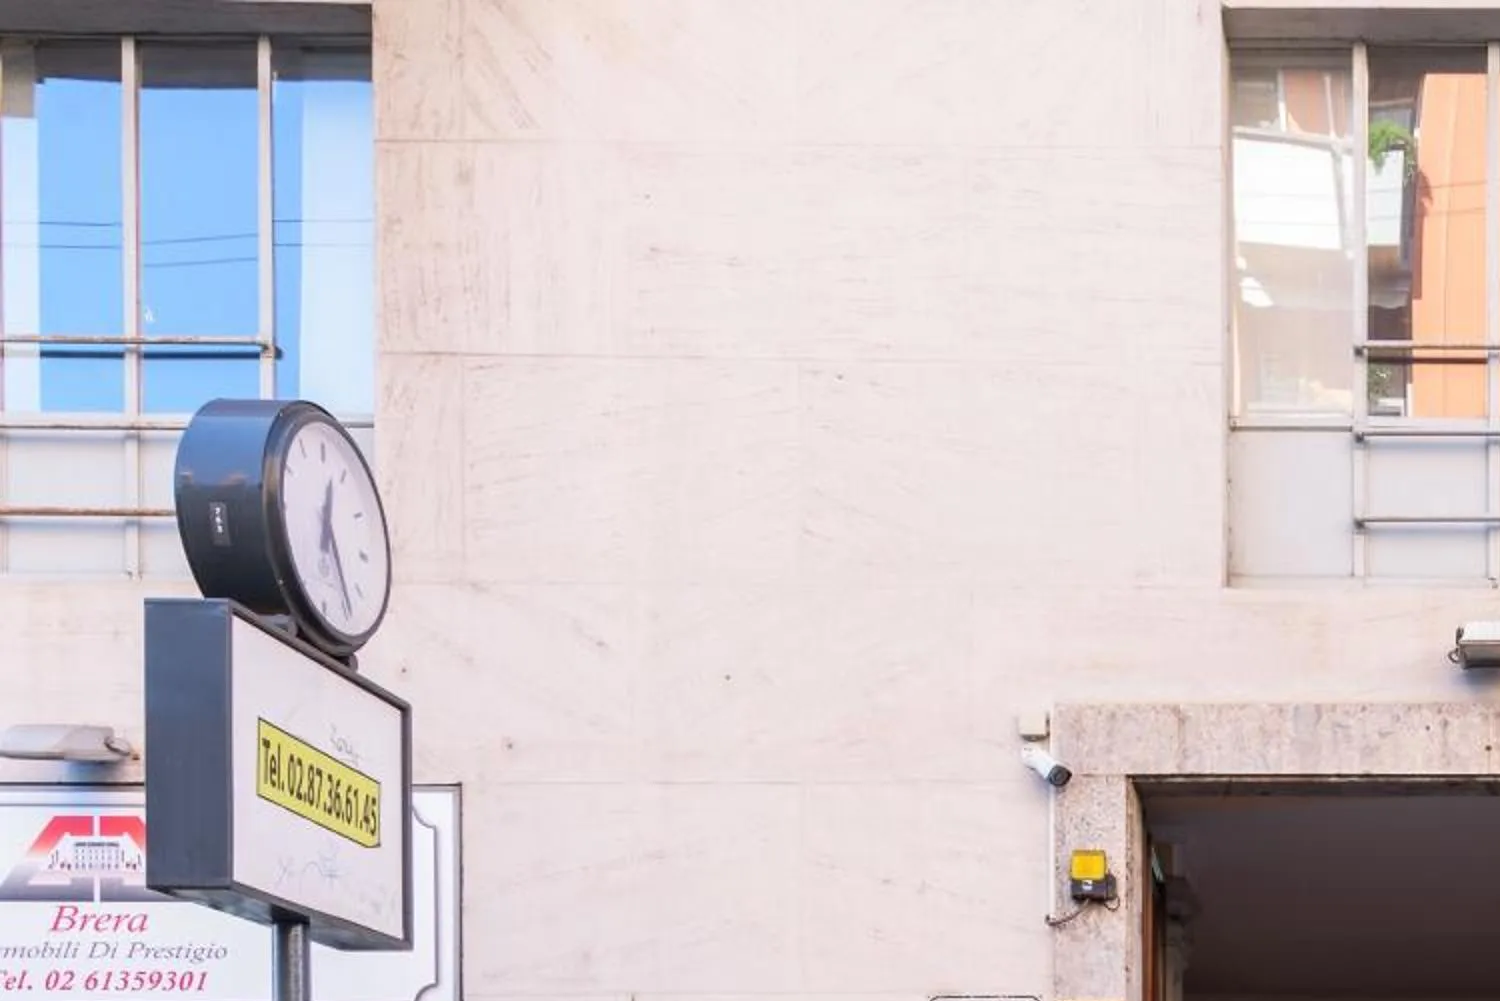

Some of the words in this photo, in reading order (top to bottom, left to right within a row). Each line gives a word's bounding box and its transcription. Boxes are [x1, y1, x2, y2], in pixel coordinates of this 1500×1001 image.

[262, 738, 285, 792] Tel.
[52, 905, 149, 932] Brera
[0, 941, 80, 959] mobili
[88, 941, 120, 959] Di
[128, 941, 228, 963] Prestigio
[45, 970, 75, 991] 02
[85, 970, 208, 991] 61359301
